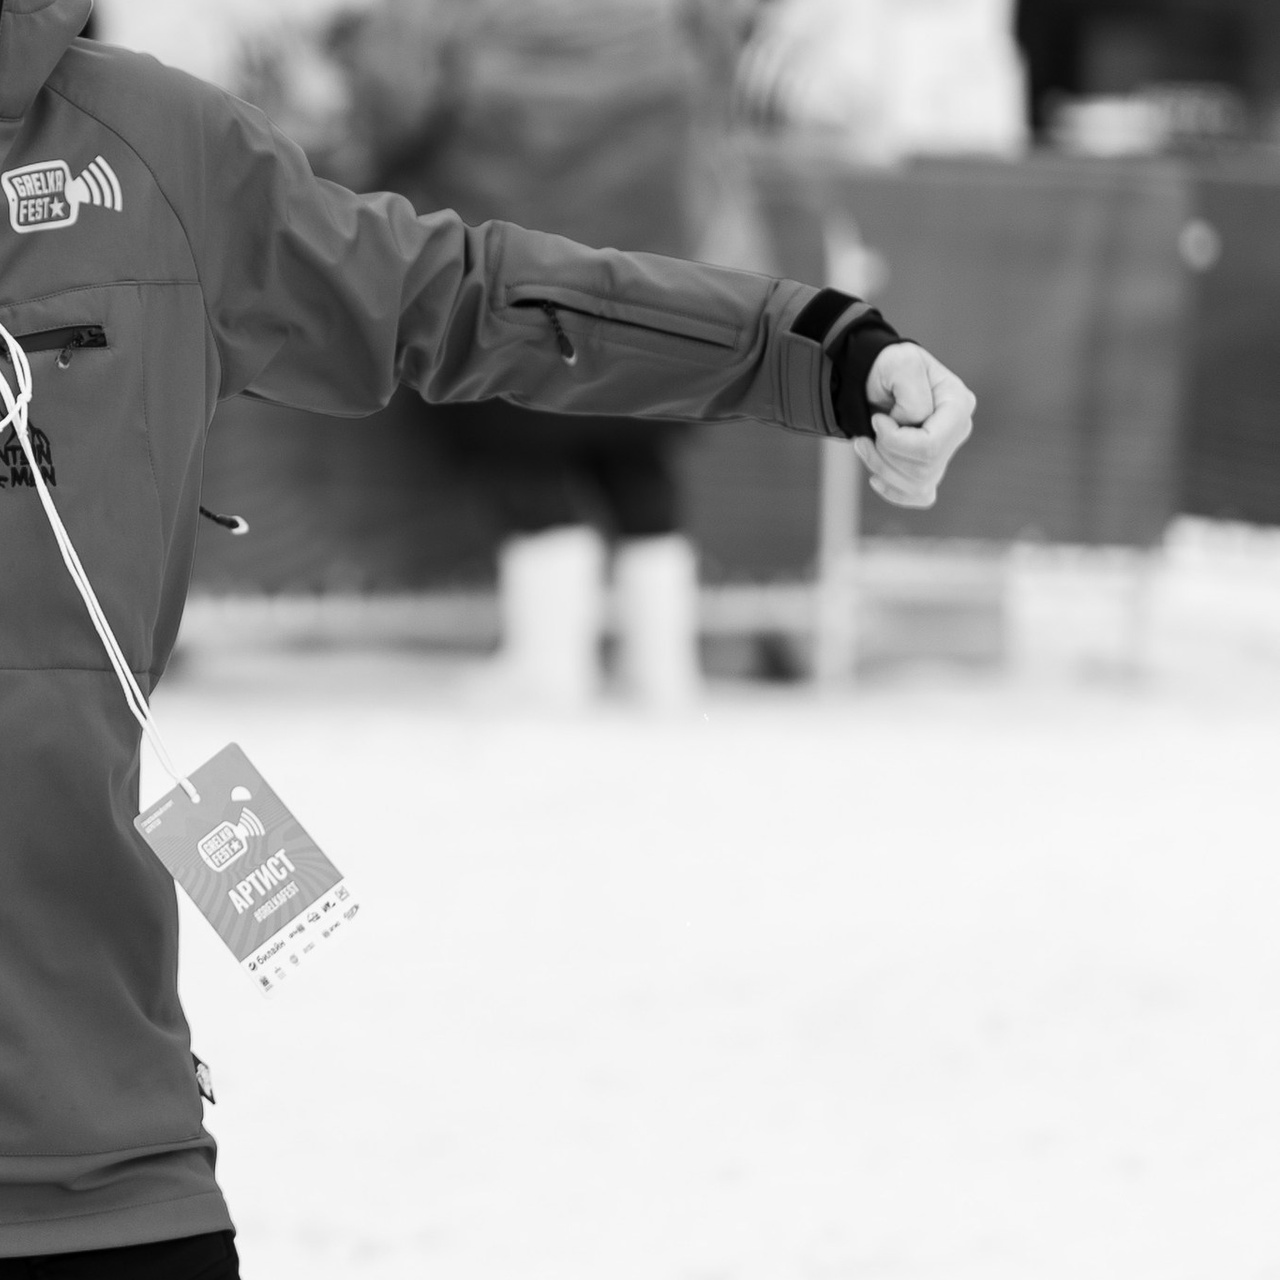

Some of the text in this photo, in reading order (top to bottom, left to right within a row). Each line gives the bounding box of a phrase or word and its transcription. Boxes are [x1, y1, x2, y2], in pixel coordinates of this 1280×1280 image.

[19, 197, 51, 223] FEST
[211, 842, 234, 868] FEST
[228, 848, 296, 915] АРТИСТ
